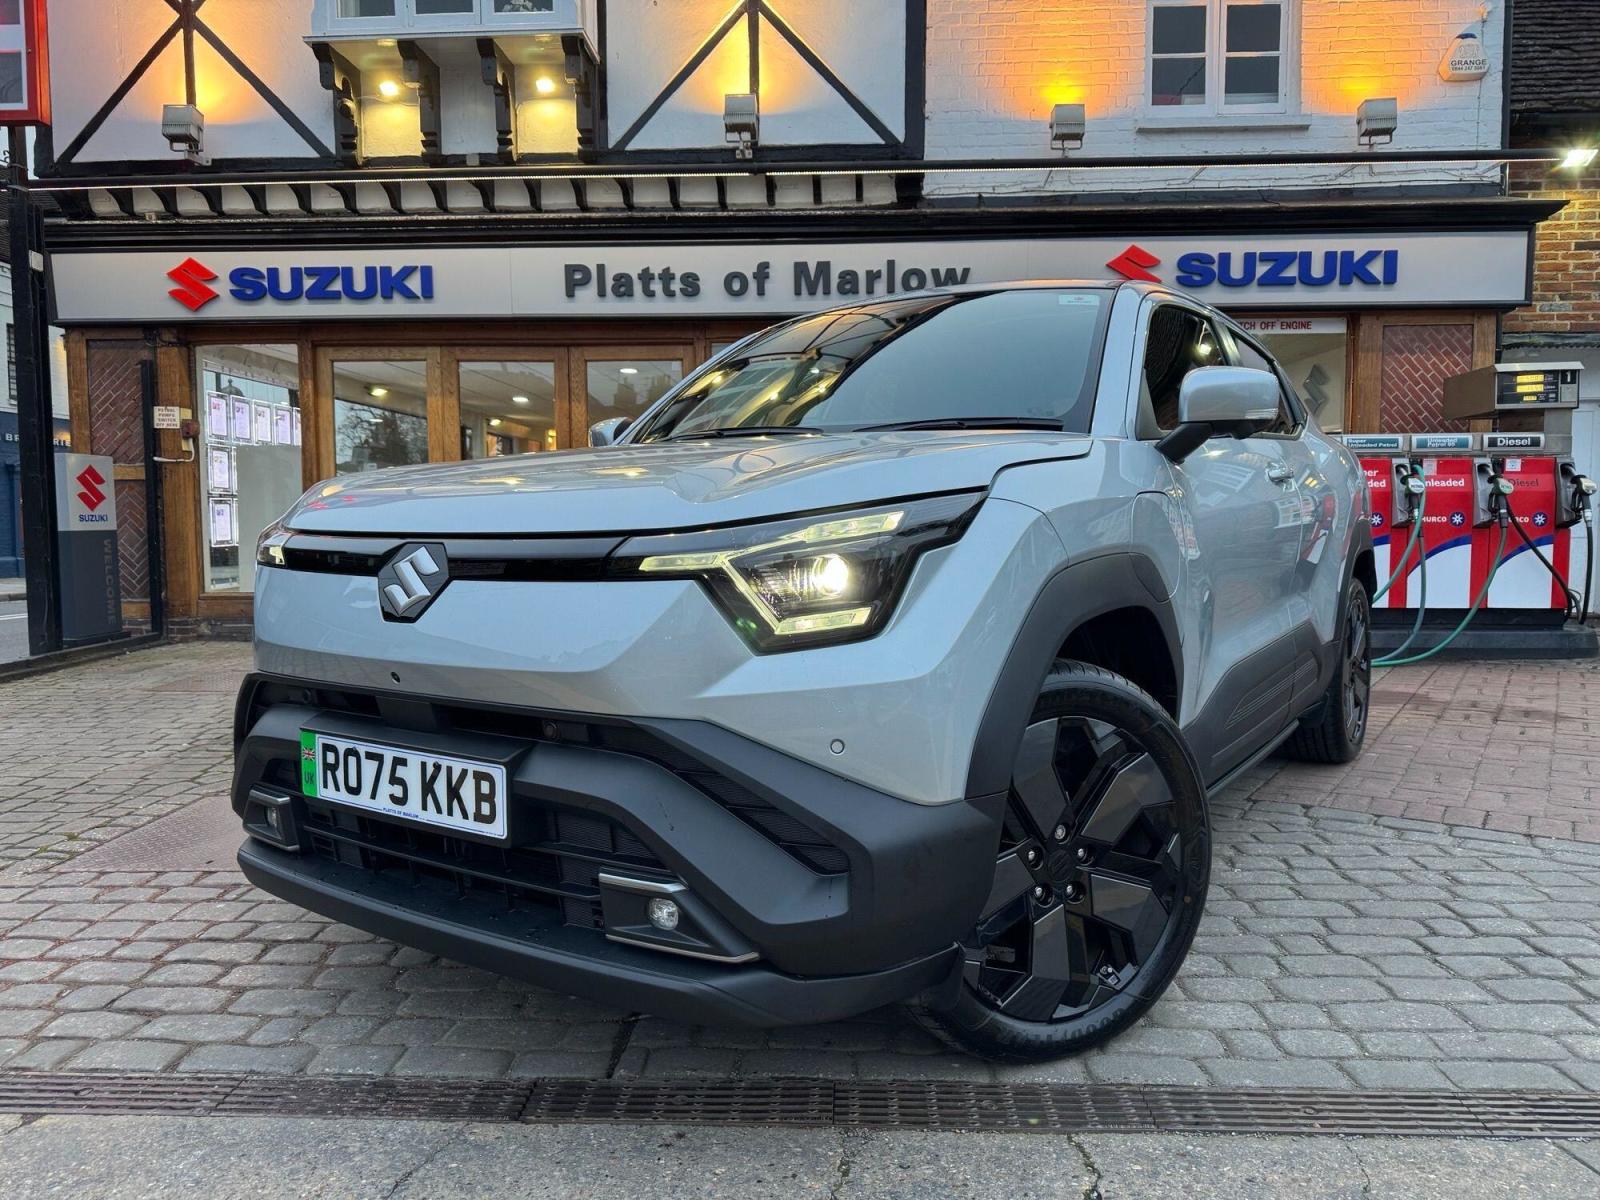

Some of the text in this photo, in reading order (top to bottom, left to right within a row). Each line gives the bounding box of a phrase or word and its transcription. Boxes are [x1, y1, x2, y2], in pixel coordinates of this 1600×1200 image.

[1176, 249, 1399, 287] SUZUKI
[228, 265, 434, 301] SUZUKI
[563, 259, 972, 298] Platts of Marlow
[1260, 321, 1276, 330] OFF
[1280, 320, 1312, 330] ENGINE
[1566, 371, 1572, 383] 1
[1497, 437, 1531, 446] Diesel
[1425, 477, 1465, 487] nleaded
[78, 514, 108, 522] SUZUKI
[103, 539, 117, 625] WELCOME
[304, 771, 314, 785] UK
[321, 742, 496, 824] RO75 KKB
